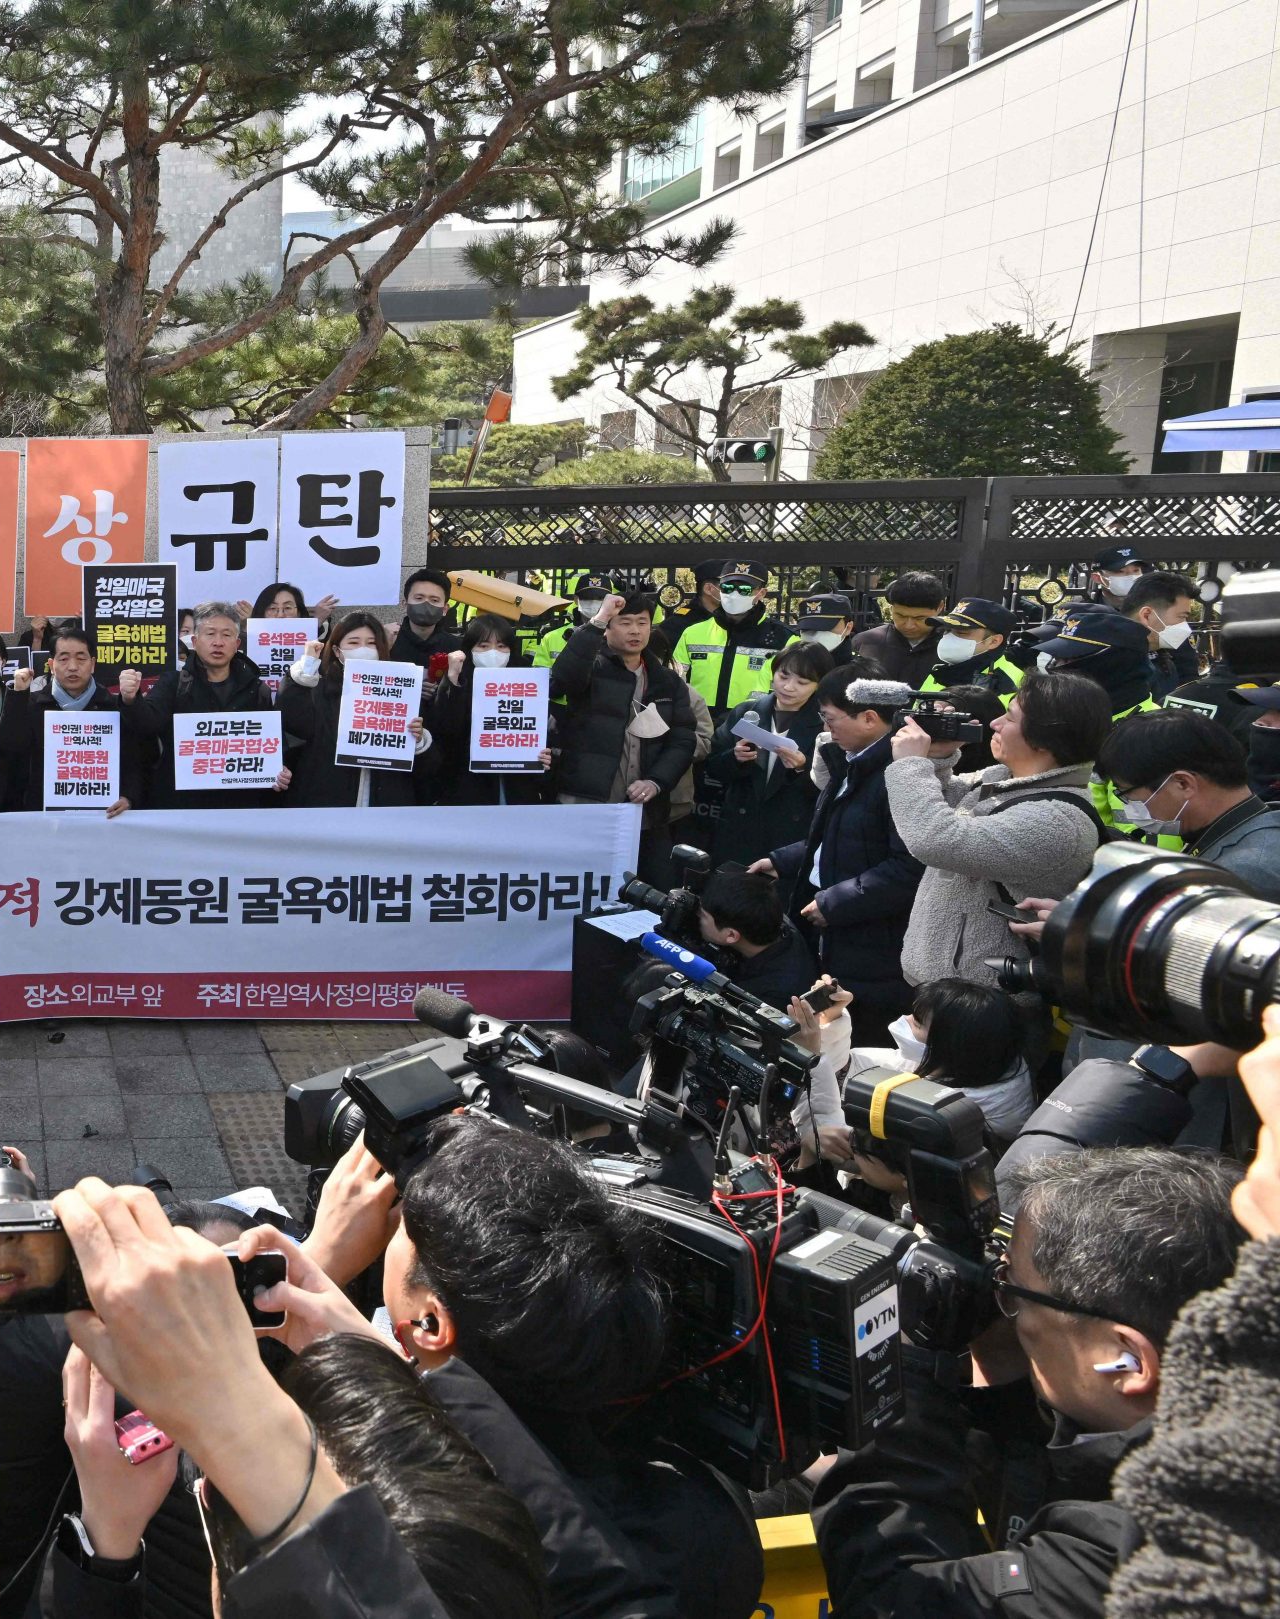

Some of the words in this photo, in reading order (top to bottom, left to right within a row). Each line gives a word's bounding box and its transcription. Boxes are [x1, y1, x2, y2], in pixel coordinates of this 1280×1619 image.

[170, 470, 396, 571] 규탄
[95, 577, 165, 596] 친일매국
[95, 599, 164, 617] 윤석열은
[97, 625, 166, 643] 굴욕해법
[258, 632, 307, 646] 윤석열은
[97, 646, 167, 664] 폐기하라
[271, 648, 294, 661] 친일
[258, 663, 292, 677] 굴욕
[352, 674, 382, 684] 반인권!
[385, 676, 415, 687] 반헌법!
[362, 686, 402, 698] 반역사적!
[484, 683, 537, 697] 윤석열은
[354, 700, 408, 717] 강제동원
[498, 700, 523, 713] 친일
[53, 724, 81, 734] 반인권!
[84, 724, 112, 734] 반헌법!
[195, 720, 262, 736] 외교부는
[352, 716, 405, 732] 굴욕해법
[483, 717, 536, 730] 굴욕외교
[63, 736, 101, 745] 반역사적!
[348, 731, 406, 748] 폐기하라!
[479, 733, 538, 747] 중단하라!
[179, 738, 280, 756] 굴욕매국협상
[57, 750, 108, 764] 강제동원
[192, 757, 264, 774] 중단하라!
[57, 766, 108, 780] 굴욕해법
[54, 782, 110, 796] 폐기하라!
[53, 877, 228, 925] 강제동원
[237, 874, 412, 924] 굴욕해법
[421, 871, 611, 922] 철회하라!
[655, 939, 681, 953] AFP
[23, 984, 69, 1008] 장소
[70, 983, 138, 1007] 외교부
[141, 983, 164, 1007] 앞
[196, 983, 241, 1008] 주최
[752, 1062, 767, 1073] SON
[873, 1304, 896, 1330] YTN
